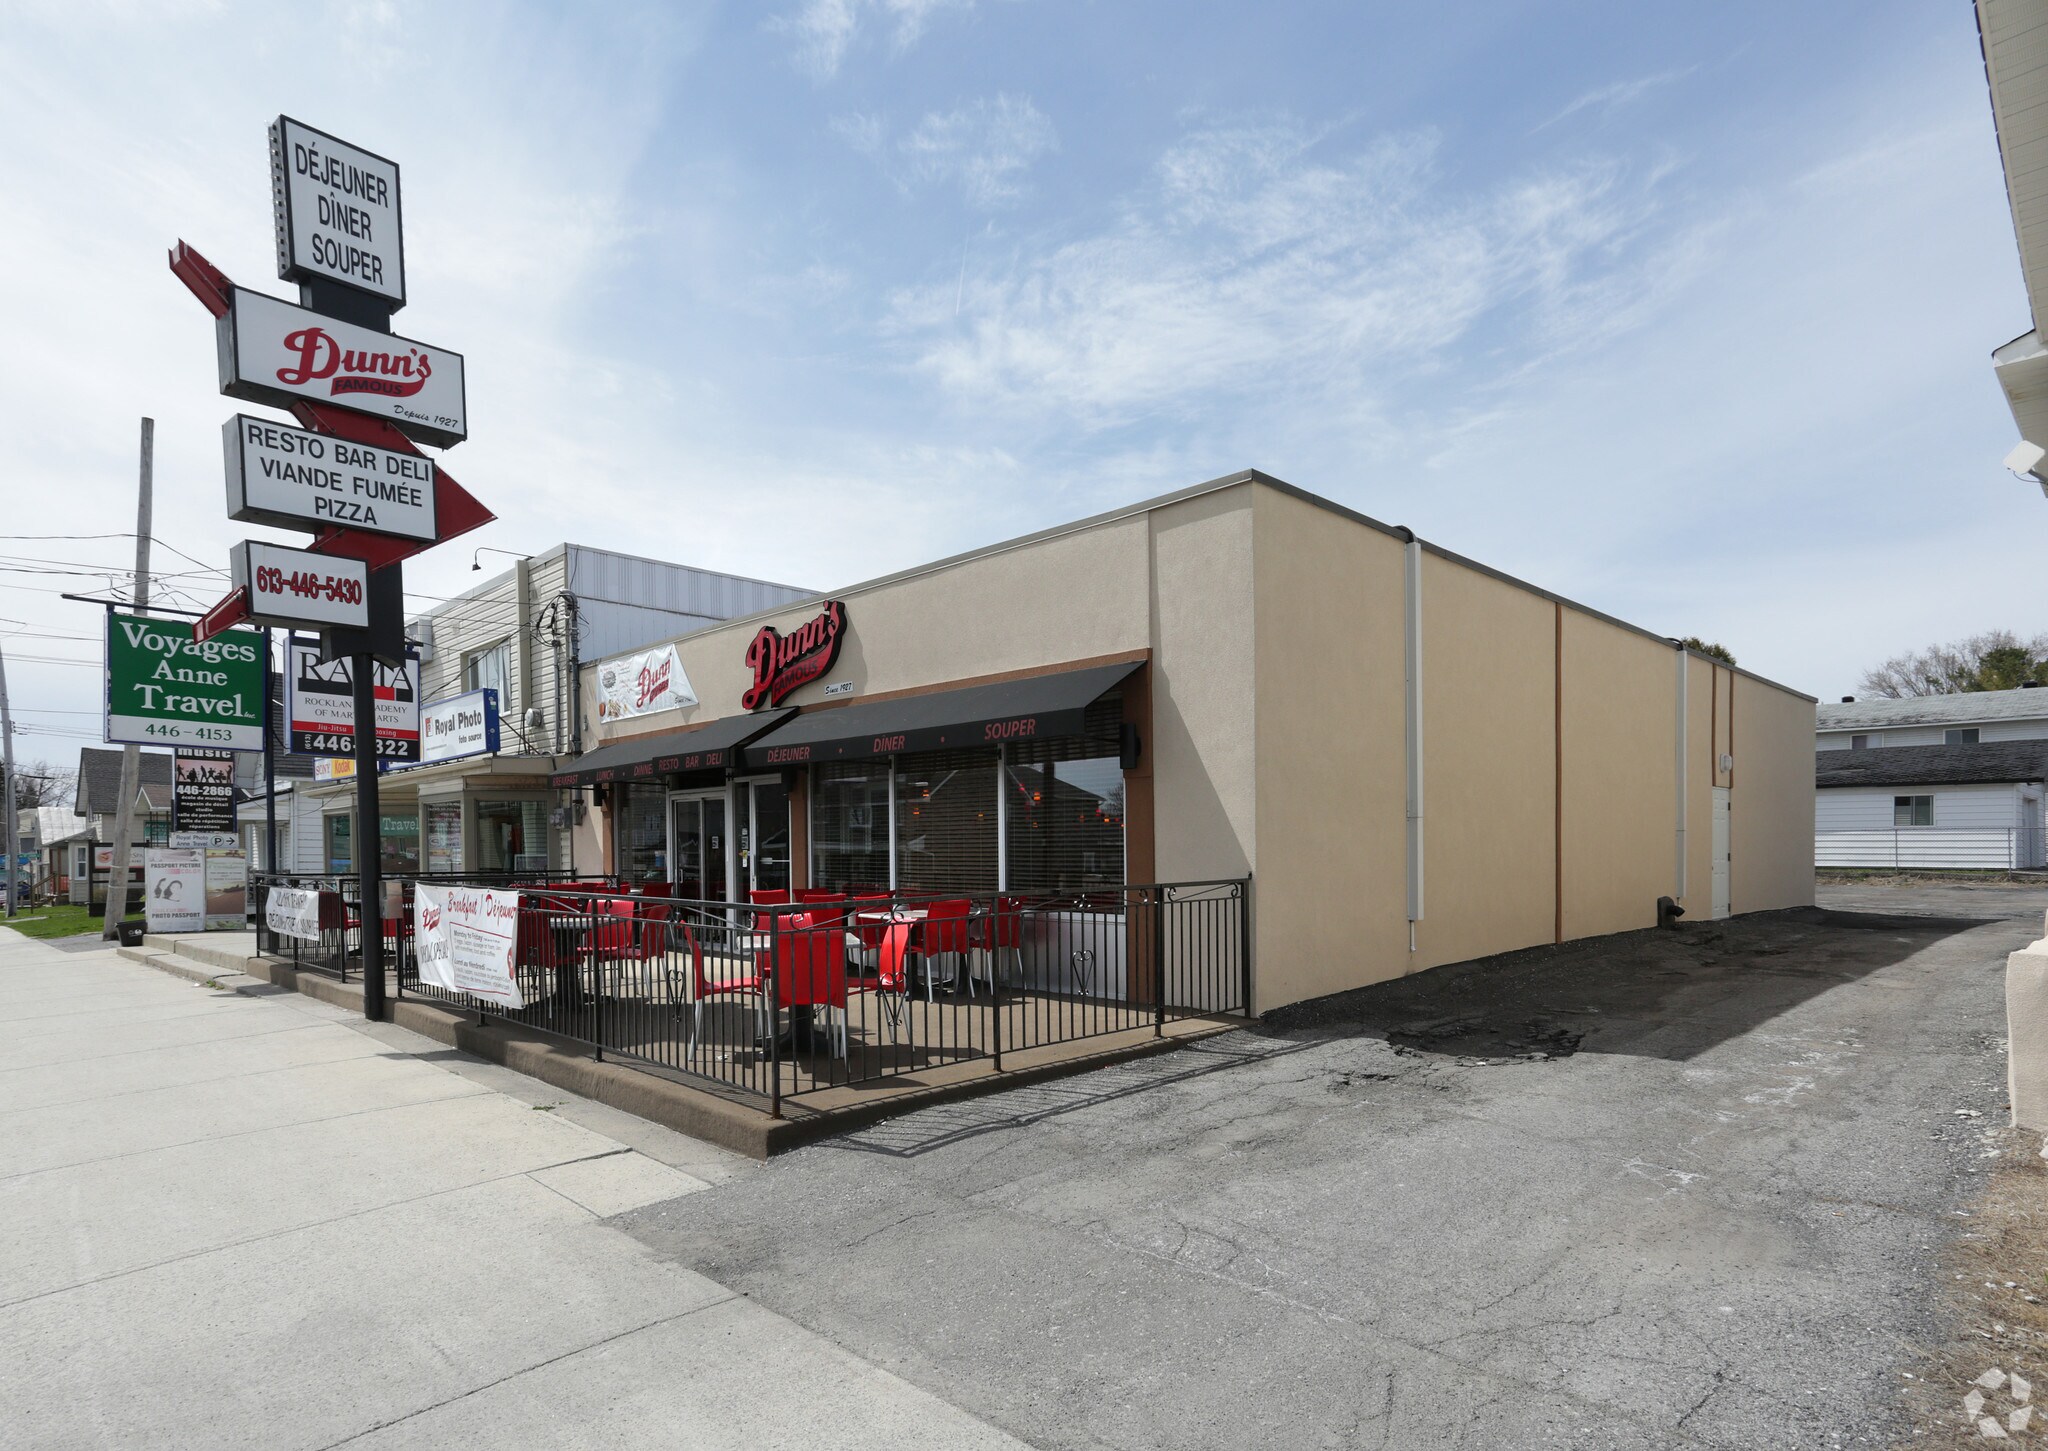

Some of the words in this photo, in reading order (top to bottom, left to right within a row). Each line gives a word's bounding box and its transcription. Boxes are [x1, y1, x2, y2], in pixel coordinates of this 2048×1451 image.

[294, 141, 389, 209] DÉJEUNER
[318, 191, 373, 242] DÎNER
[311, 233, 384, 286] SOUPER
[276, 327, 432, 385] Dunn's
[334, 379, 404, 395] FAMOUS
[394, 404, 430, 421] Depuis
[433, 415, 458, 428] 1927
[248, 423, 325, 459] RESTO
[334, 443, 377, 471] BAR
[386, 455, 430, 482] DELI
[259, 456, 343, 492] VIANDE
[352, 476, 423, 508] FUMÉE
[314, 495, 378, 525] PIZZA
[256, 565, 362, 605] 613-446-5430
[118, 621, 256, 664] Voyages
[742, 600, 840, 710] Dunn's
[151, 659, 228, 686] Anne
[774, 659, 818, 693] FAMOUS
[133, 683, 243, 717] Travel
[824, 684, 839, 696] Since
[839, 681, 852, 693] 1927
[304, 697, 352, 709] ROCKLAN
[374, 704, 408, 714] ADEMY
[315, 708, 328, 717] OF
[377, 714, 399, 723] ARTS
[317, 723, 347, 732] Jiu-Jitsu
[434, 714, 456, 736] Royal
[457, 709, 482, 729] Photo
[313, 734, 408, 756] 446-322
[467, 733, 482, 742] source
[767, 746, 810, 763] DÉJEUNER
[873, 735, 905, 752] DÎNER
[984, 718, 1036, 740] SOUPER
[177, 748, 231, 758] music
[334, 759, 351, 774] Kodak
[658, 757, 679, 770] RESTO
[685, 755, 699, 768] BAR
[706, 752, 723, 765] DELI
[176, 785, 232, 796] 446-2866
[553, 774, 579, 786] BREAKFAST
[596, 770, 614, 781] LUNCH
[383, 817, 420, 831] Travel
[447, 891, 478, 921] Breakfast
[485, 893, 517, 927] Déjeuner
